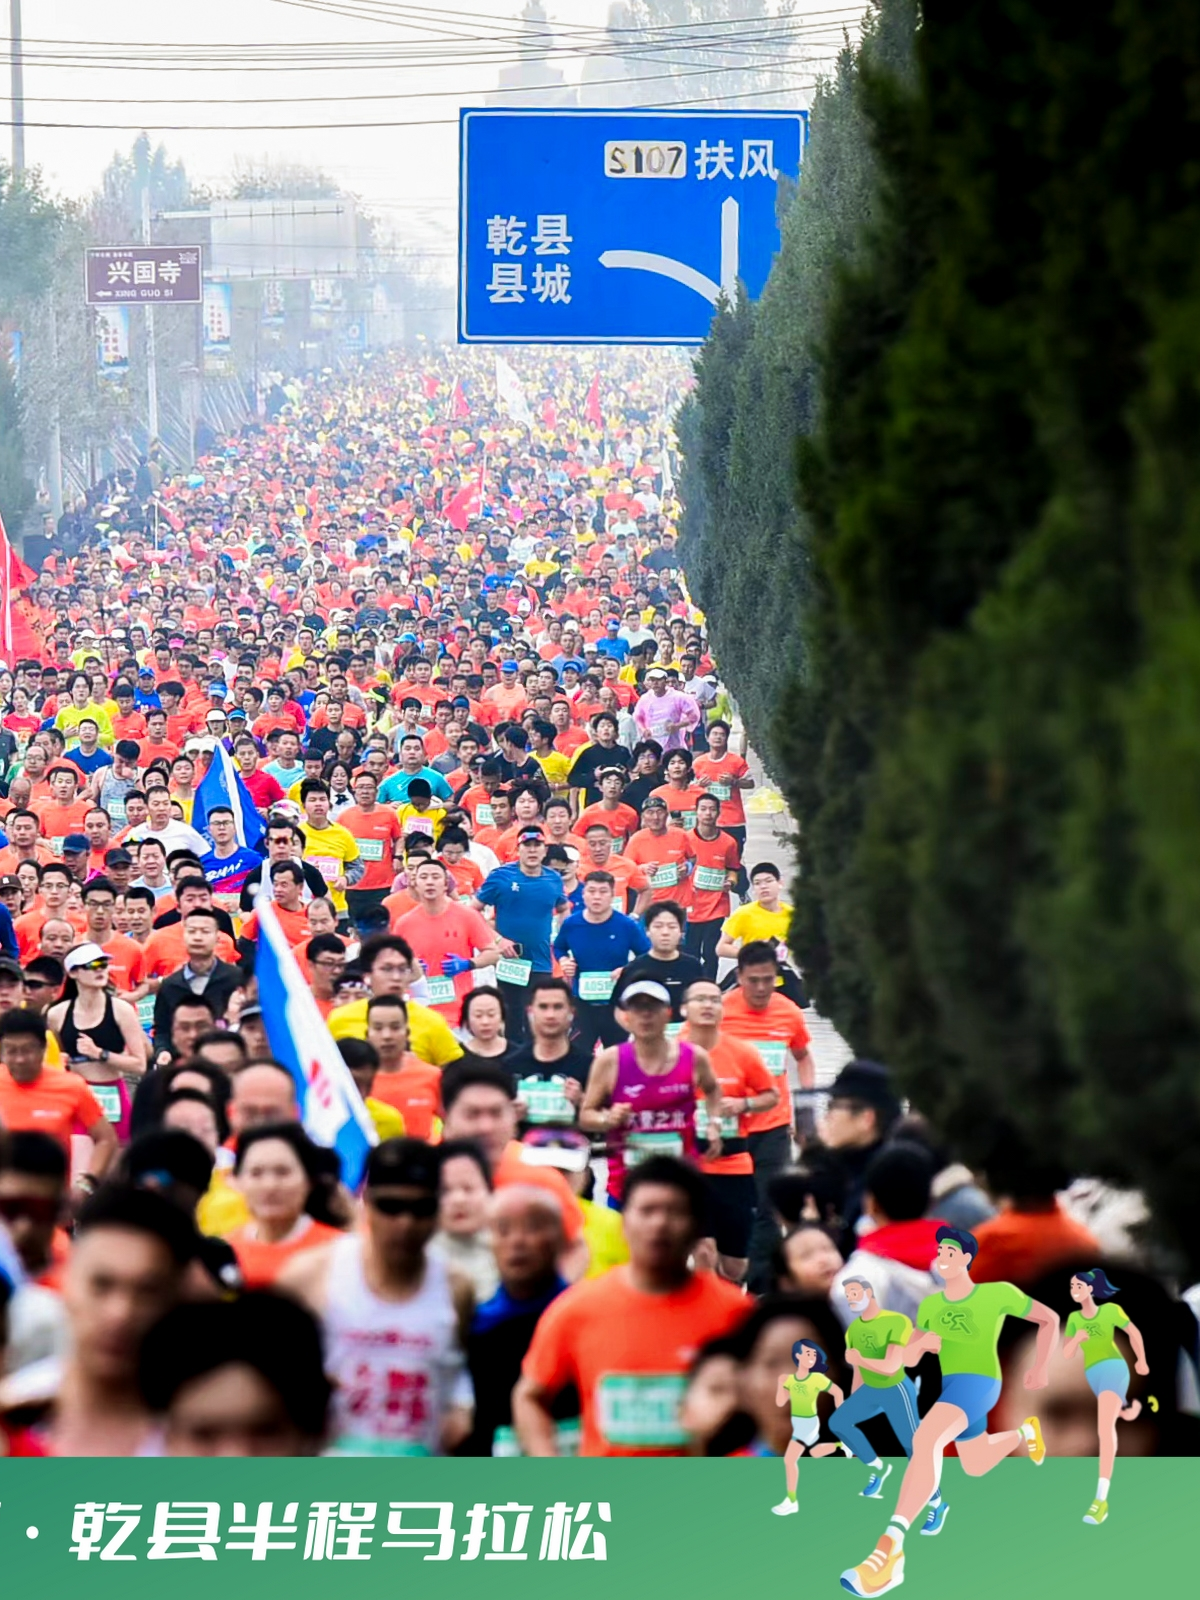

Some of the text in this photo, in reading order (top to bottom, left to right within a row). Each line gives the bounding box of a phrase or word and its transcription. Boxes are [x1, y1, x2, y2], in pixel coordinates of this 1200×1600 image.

[609, 139, 779, 181] S107 扶风
[486, 215, 573, 256] 乾县
[107, 260, 182, 285] 兴国寺
[115, 288, 173, 297] XING GUO SI
[486, 263, 573, 304] 县城
